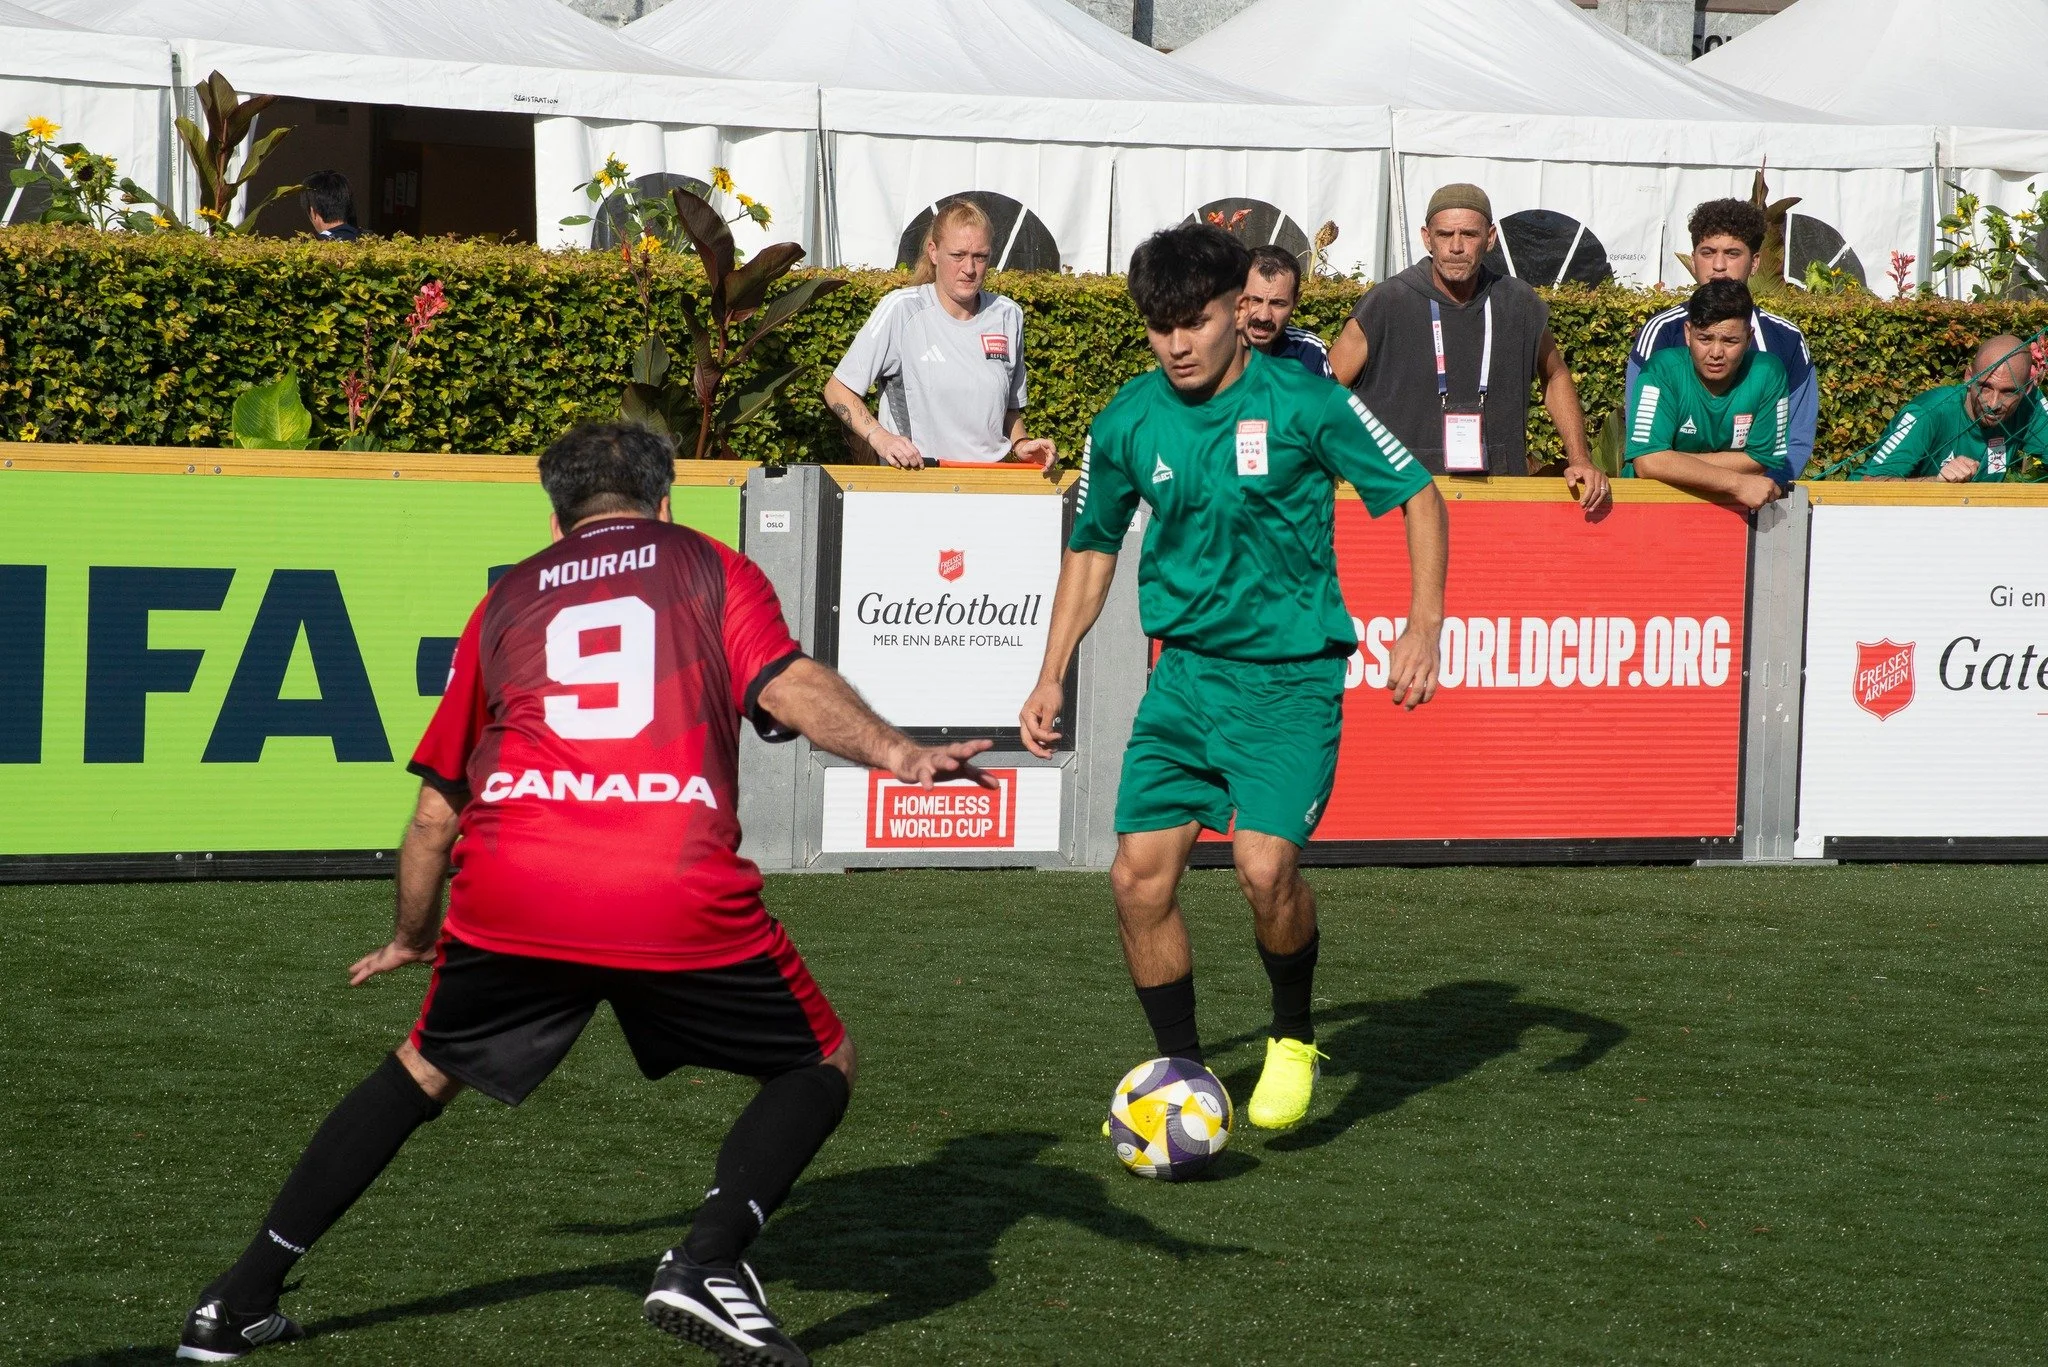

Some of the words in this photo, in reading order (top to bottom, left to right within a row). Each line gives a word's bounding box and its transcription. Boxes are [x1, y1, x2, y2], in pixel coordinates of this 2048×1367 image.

[514, 94, 558, 104] REGISTRATION
[857, 592, 1042, 626] Gatefotball
[1990, 584, 2014, 607] Gi
[2021, 591, 2046, 607] en
[873, 634, 898, 646] MER
[903, 634, 930, 646] ENN
[934, 635, 965, 647] BARE
[969, 635, 1023, 647] FOTBALL
[1344, 615, 1732, 689] SSORLDCUP.ORG
[543, 595, 656, 740] 9
[1863, 667, 1909, 705] ARMEEN
[480, 769, 718, 810] CANADA
[893, 795, 990, 816] HOMELESS
[889, 818, 953, 838] WORLD
[955, 818, 993, 838] CUP
